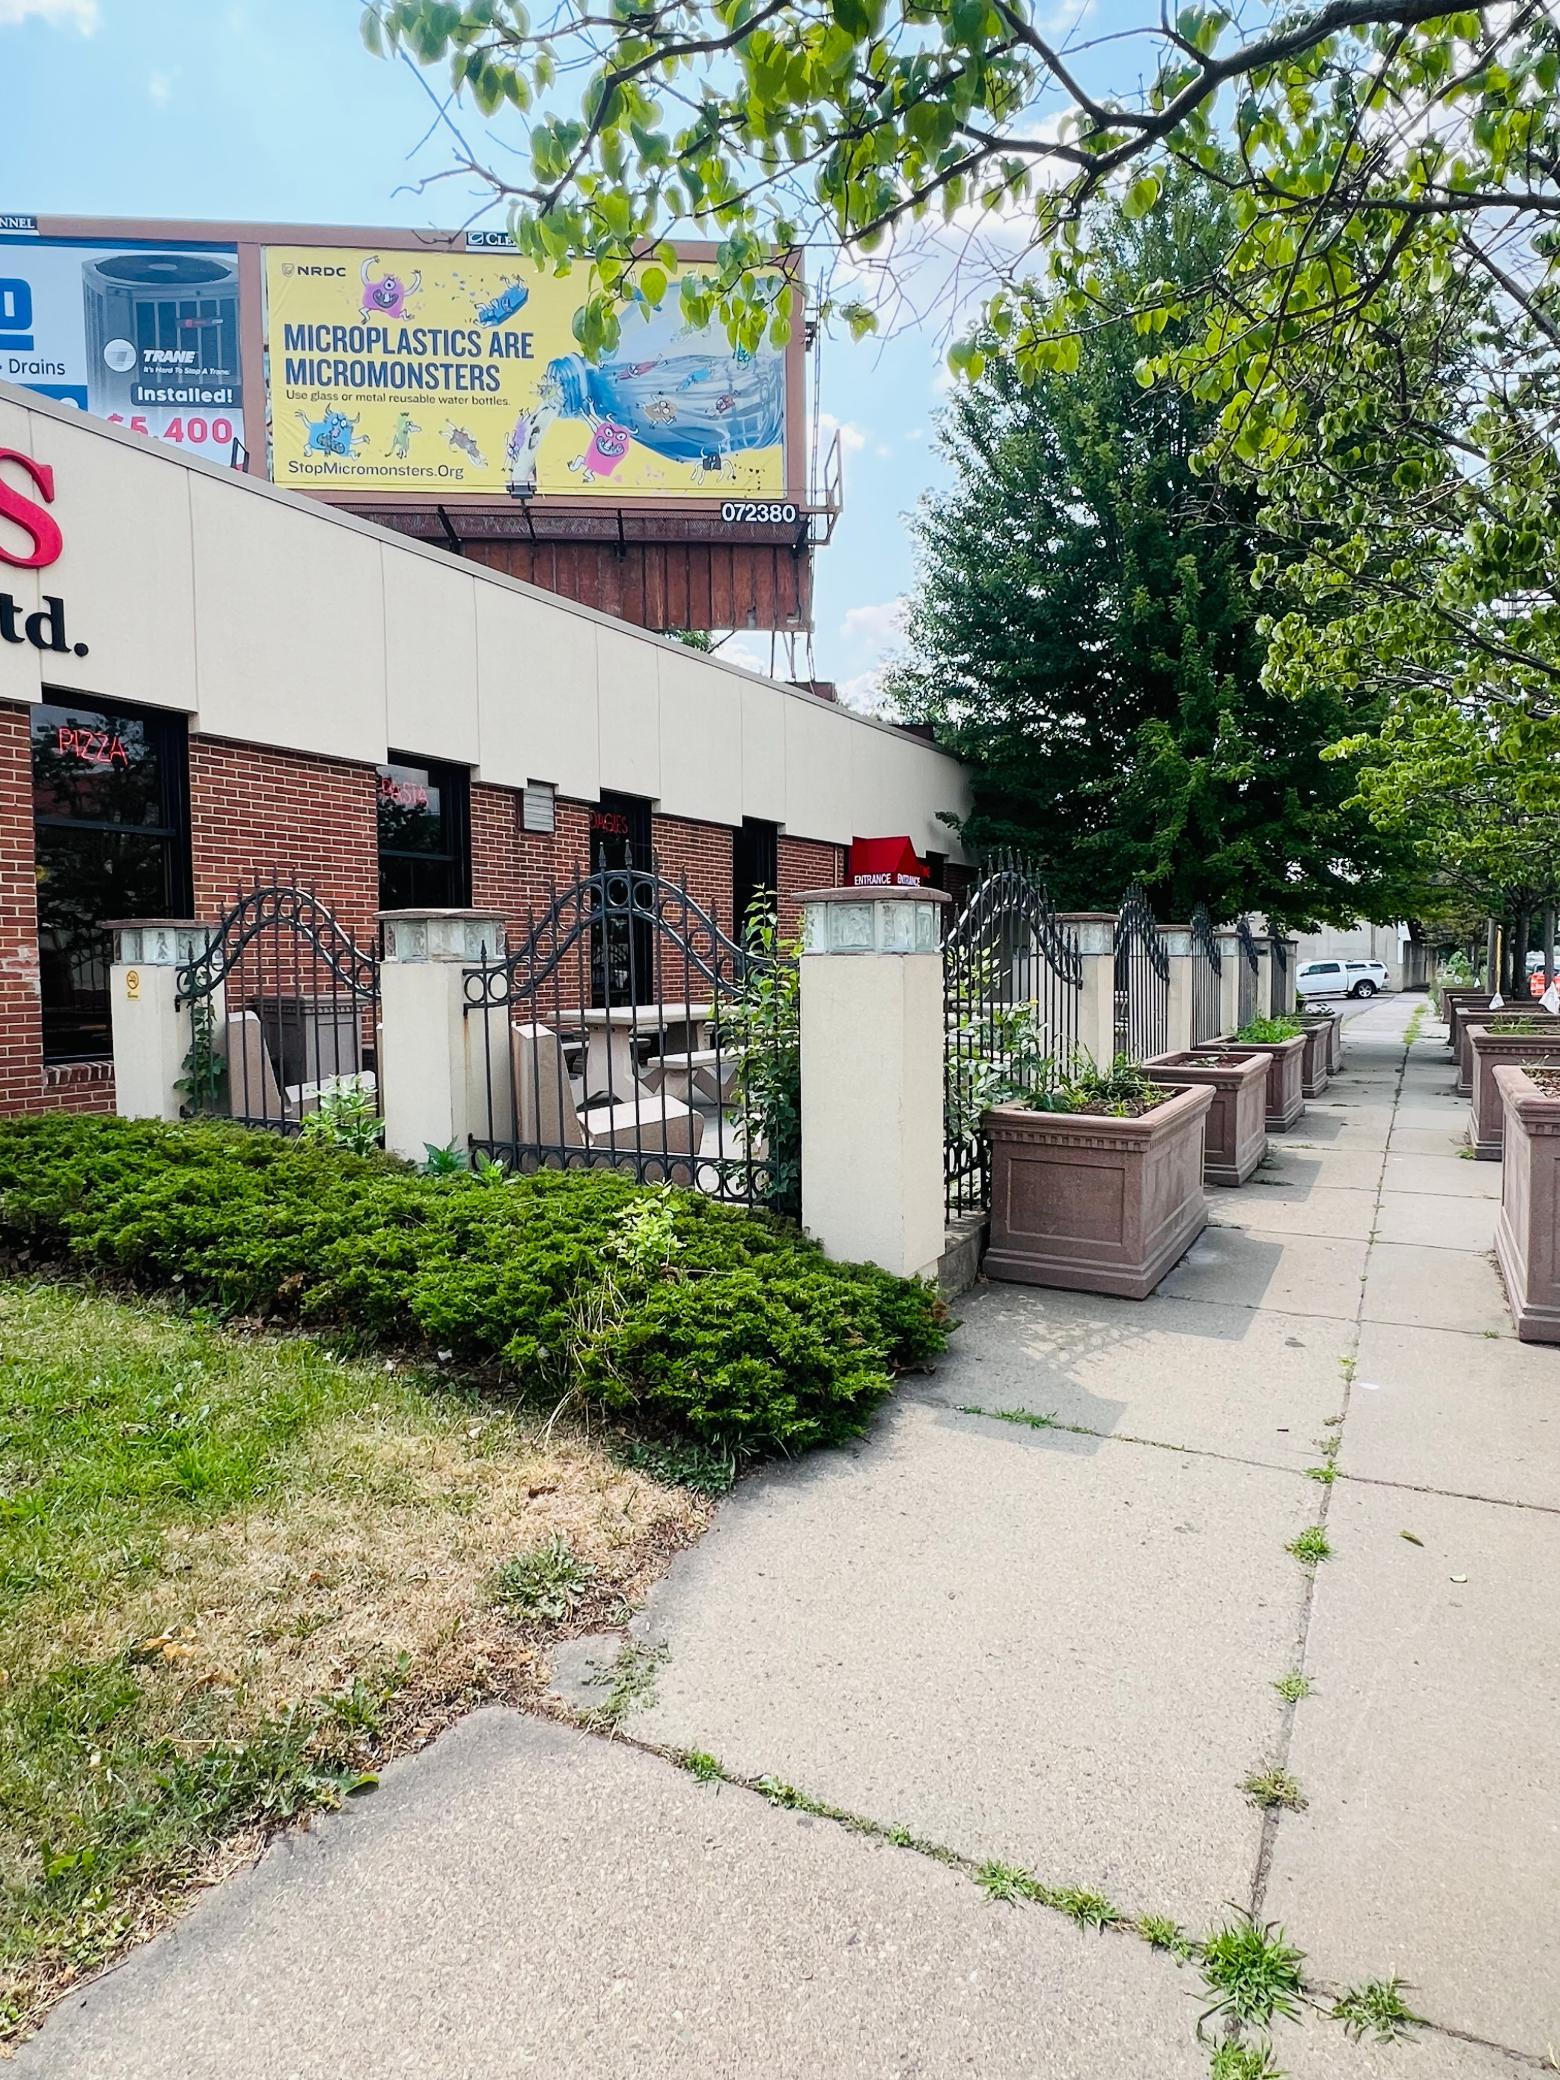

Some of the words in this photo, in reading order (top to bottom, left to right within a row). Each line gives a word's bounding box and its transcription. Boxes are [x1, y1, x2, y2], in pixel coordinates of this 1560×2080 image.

[297, 266, 347, 277] NRDC
[284, 324, 482, 358] MICROPLASTICS
[489, 332, 534, 359] ARE
[143, 350, 196, 364] TRANE
[9, 358, 66, 376] Drains
[285, 358, 500, 392] MICROMONSTERS
[137, 386, 233, 404] Installed!
[286, 390, 308, 400] Use
[311, 390, 339, 402] glass
[341, 393, 353, 401] or
[356, 393, 386, 402] metal
[389, 394, 436, 404] reusable
[439, 396, 468, 404] water
[472, 396, 510, 406] bottles.
[288, 461, 464, 480] StopMicromonsters.Org
[722, 503, 796, 523] 072380
[59, 727, 129, 767] PIZZA
[854, 873, 891, 885] ENTRANCE
